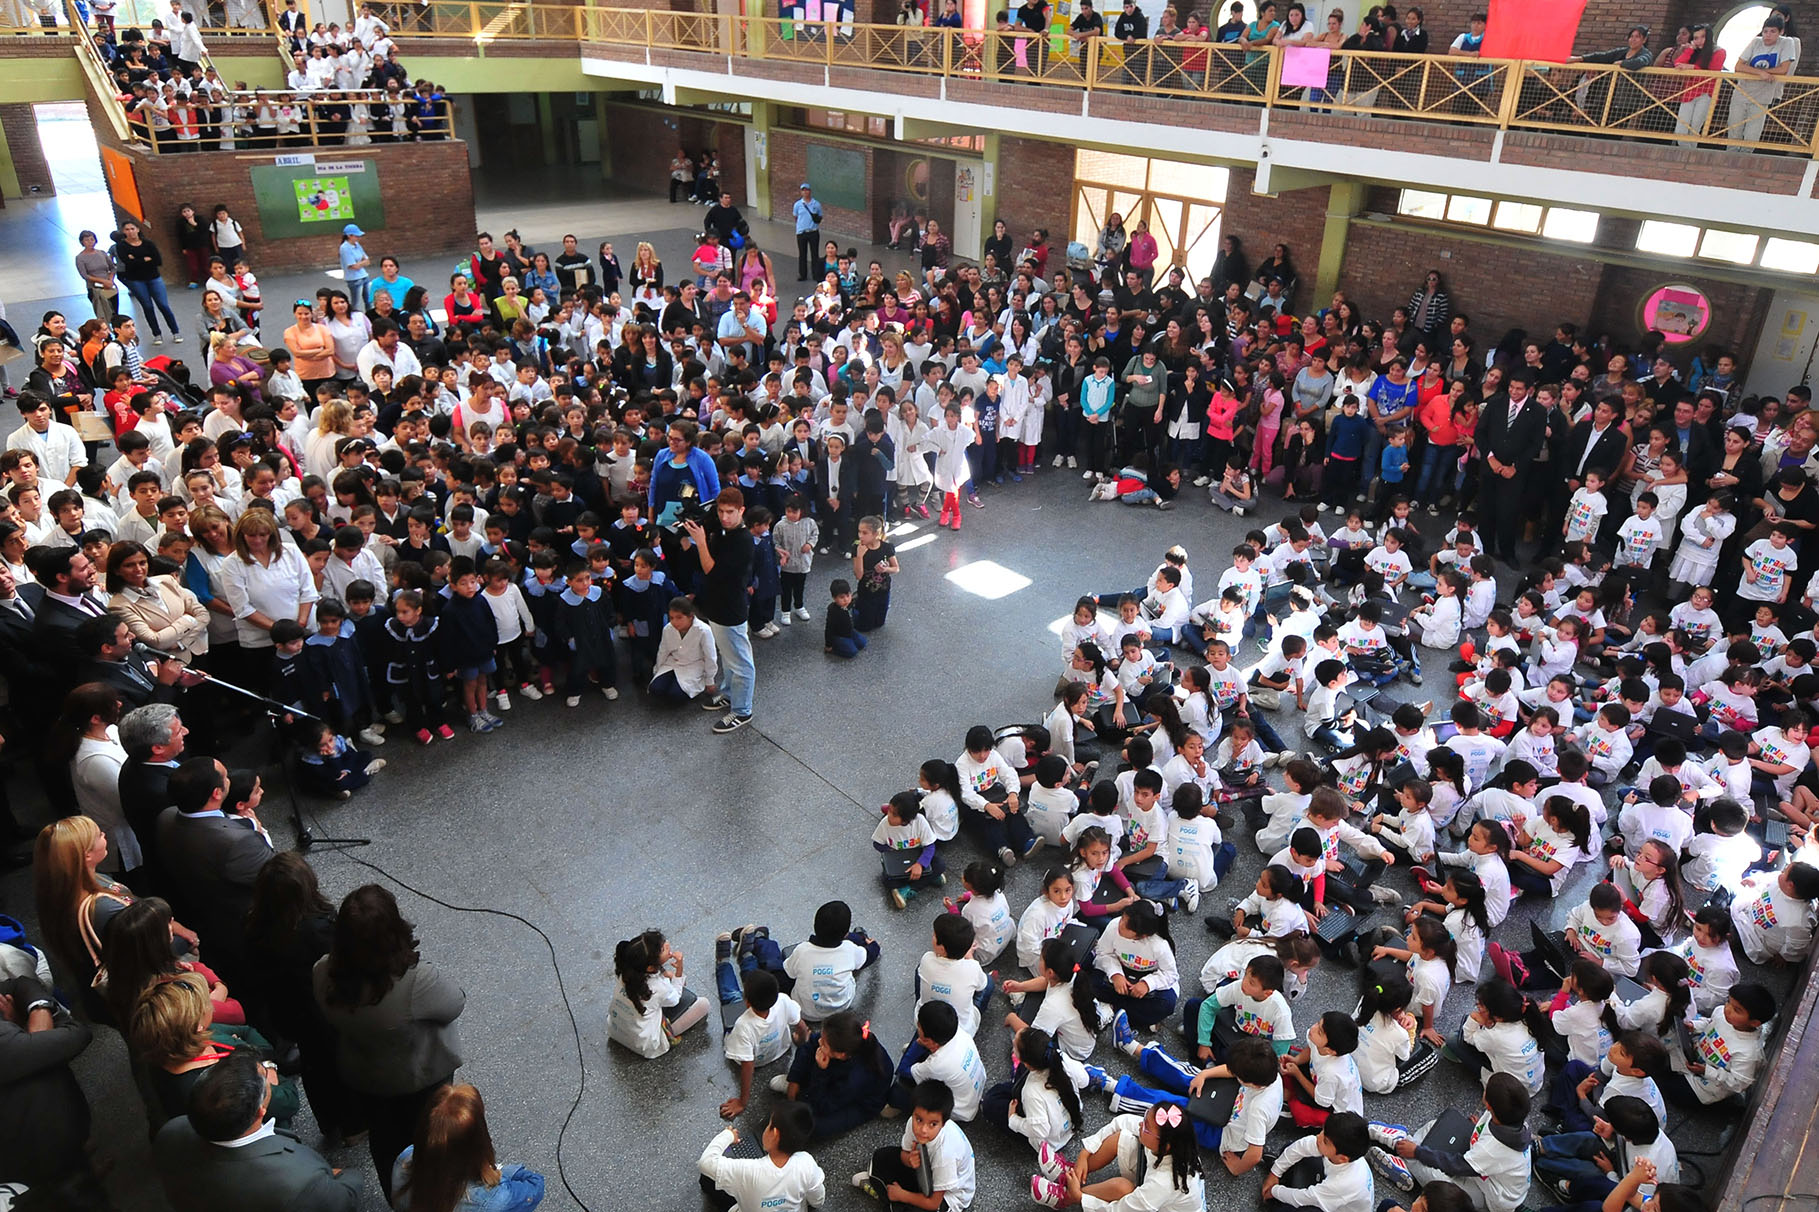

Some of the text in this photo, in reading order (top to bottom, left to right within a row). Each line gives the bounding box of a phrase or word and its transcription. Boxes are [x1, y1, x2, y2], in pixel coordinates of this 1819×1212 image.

[277, 157, 301, 165] ABRIL
[931, 985, 951, 994] POGGI
[1244, 1011, 1274, 1033] grado
